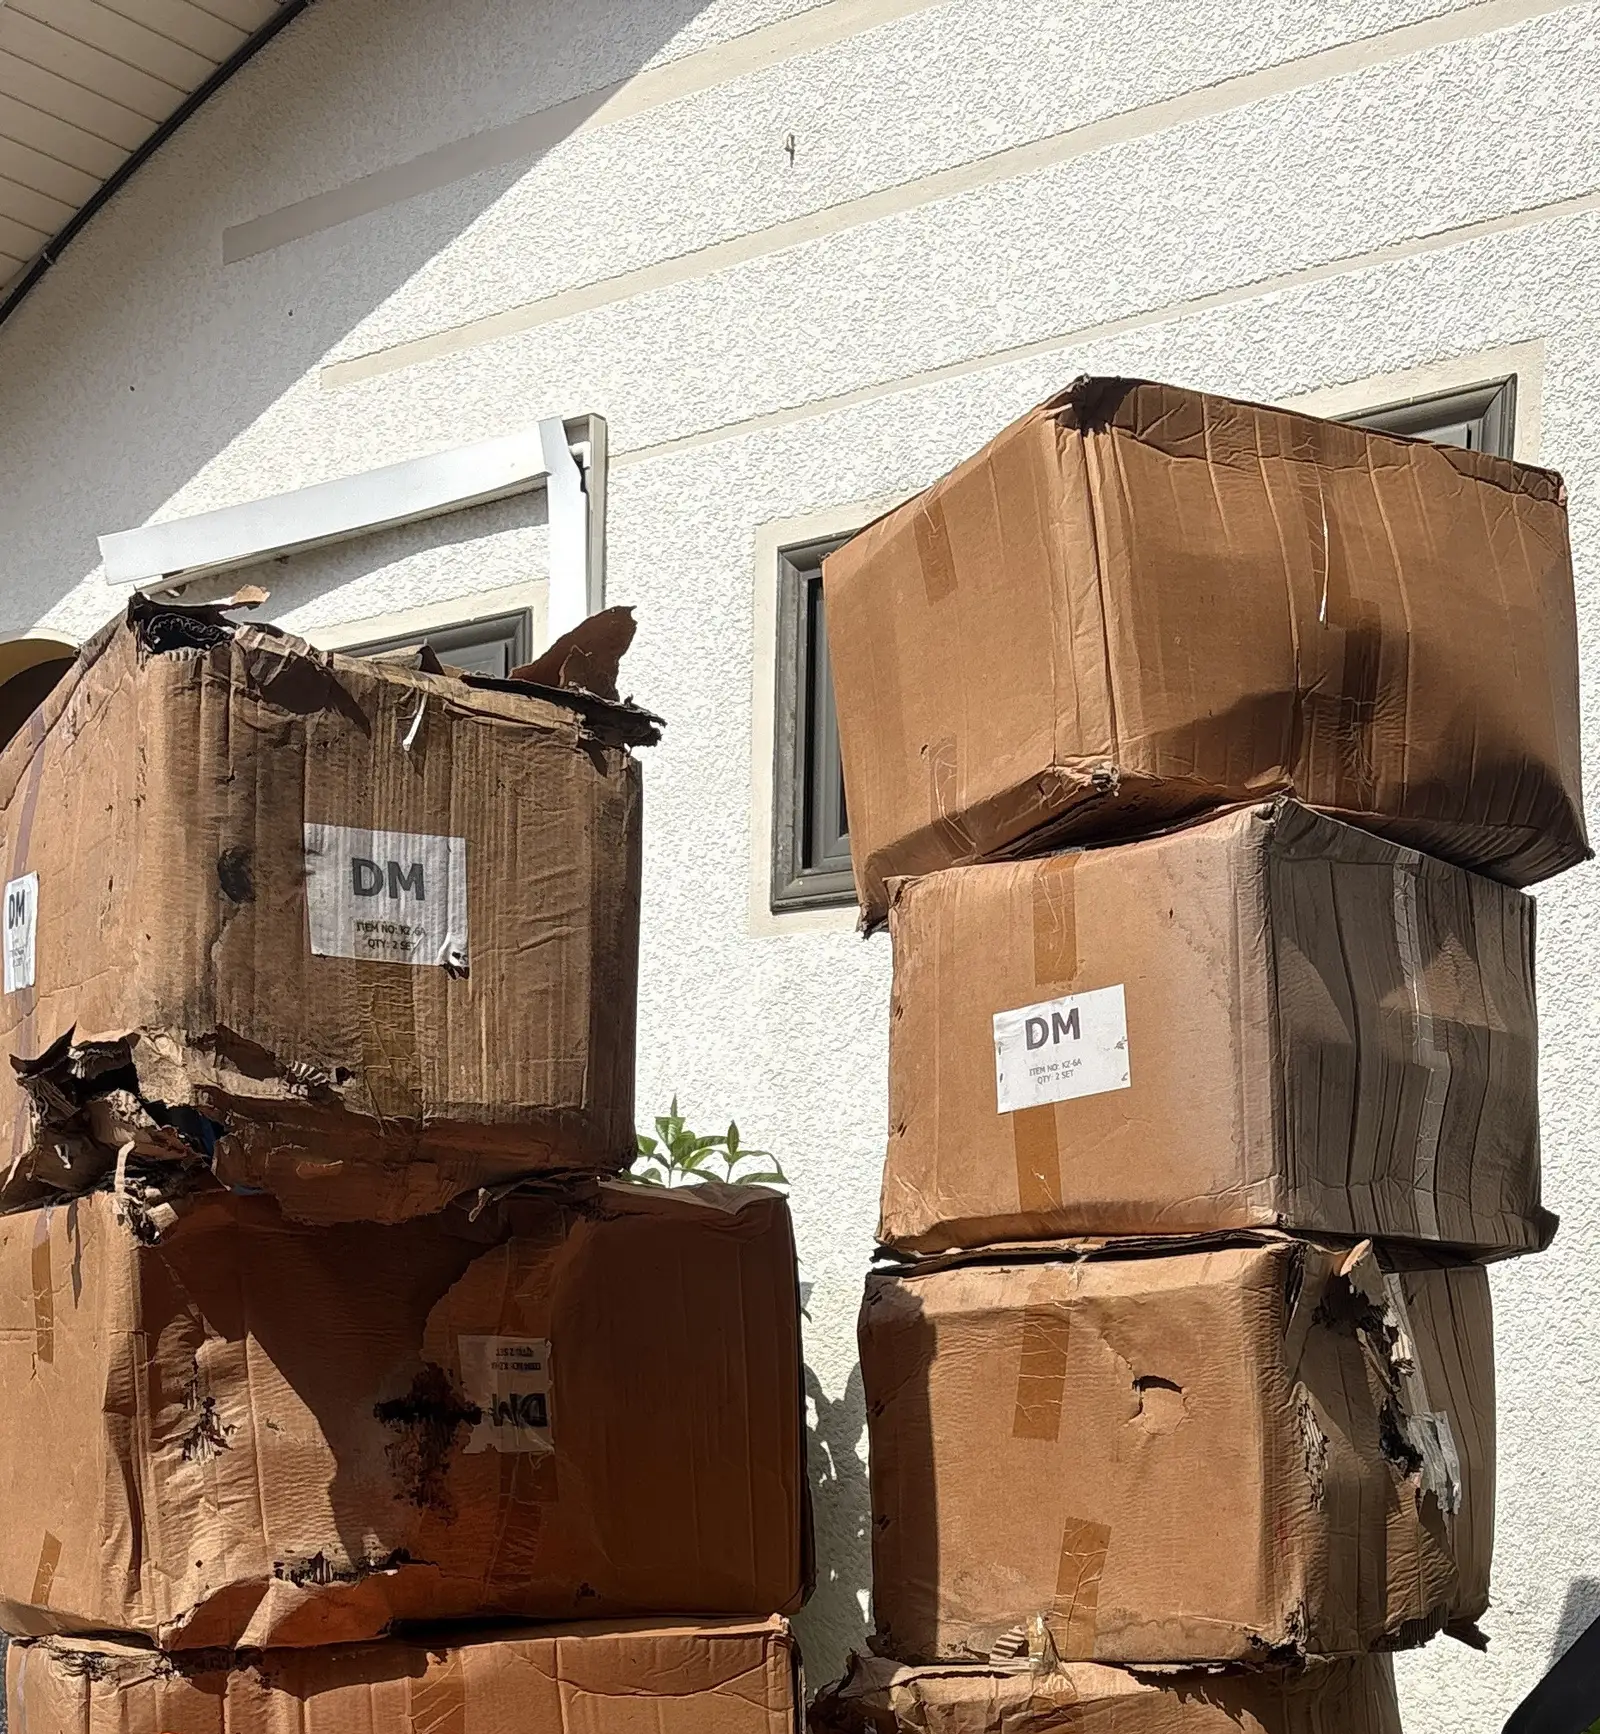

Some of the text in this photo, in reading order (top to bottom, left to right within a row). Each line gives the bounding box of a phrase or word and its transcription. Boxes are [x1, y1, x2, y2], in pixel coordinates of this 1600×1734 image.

[352, 857, 425, 901] DM
[8, 889, 25, 930] DM
[356, 921, 379, 933] ITEM
[391, 940, 399, 950] 2
[1024, 1007, 1081, 1051] DM
[1029, 1066, 1046, 1077] ITEM
[1061, 1069, 1074, 1079] SET
[491, 1392, 548, 1428] DM
